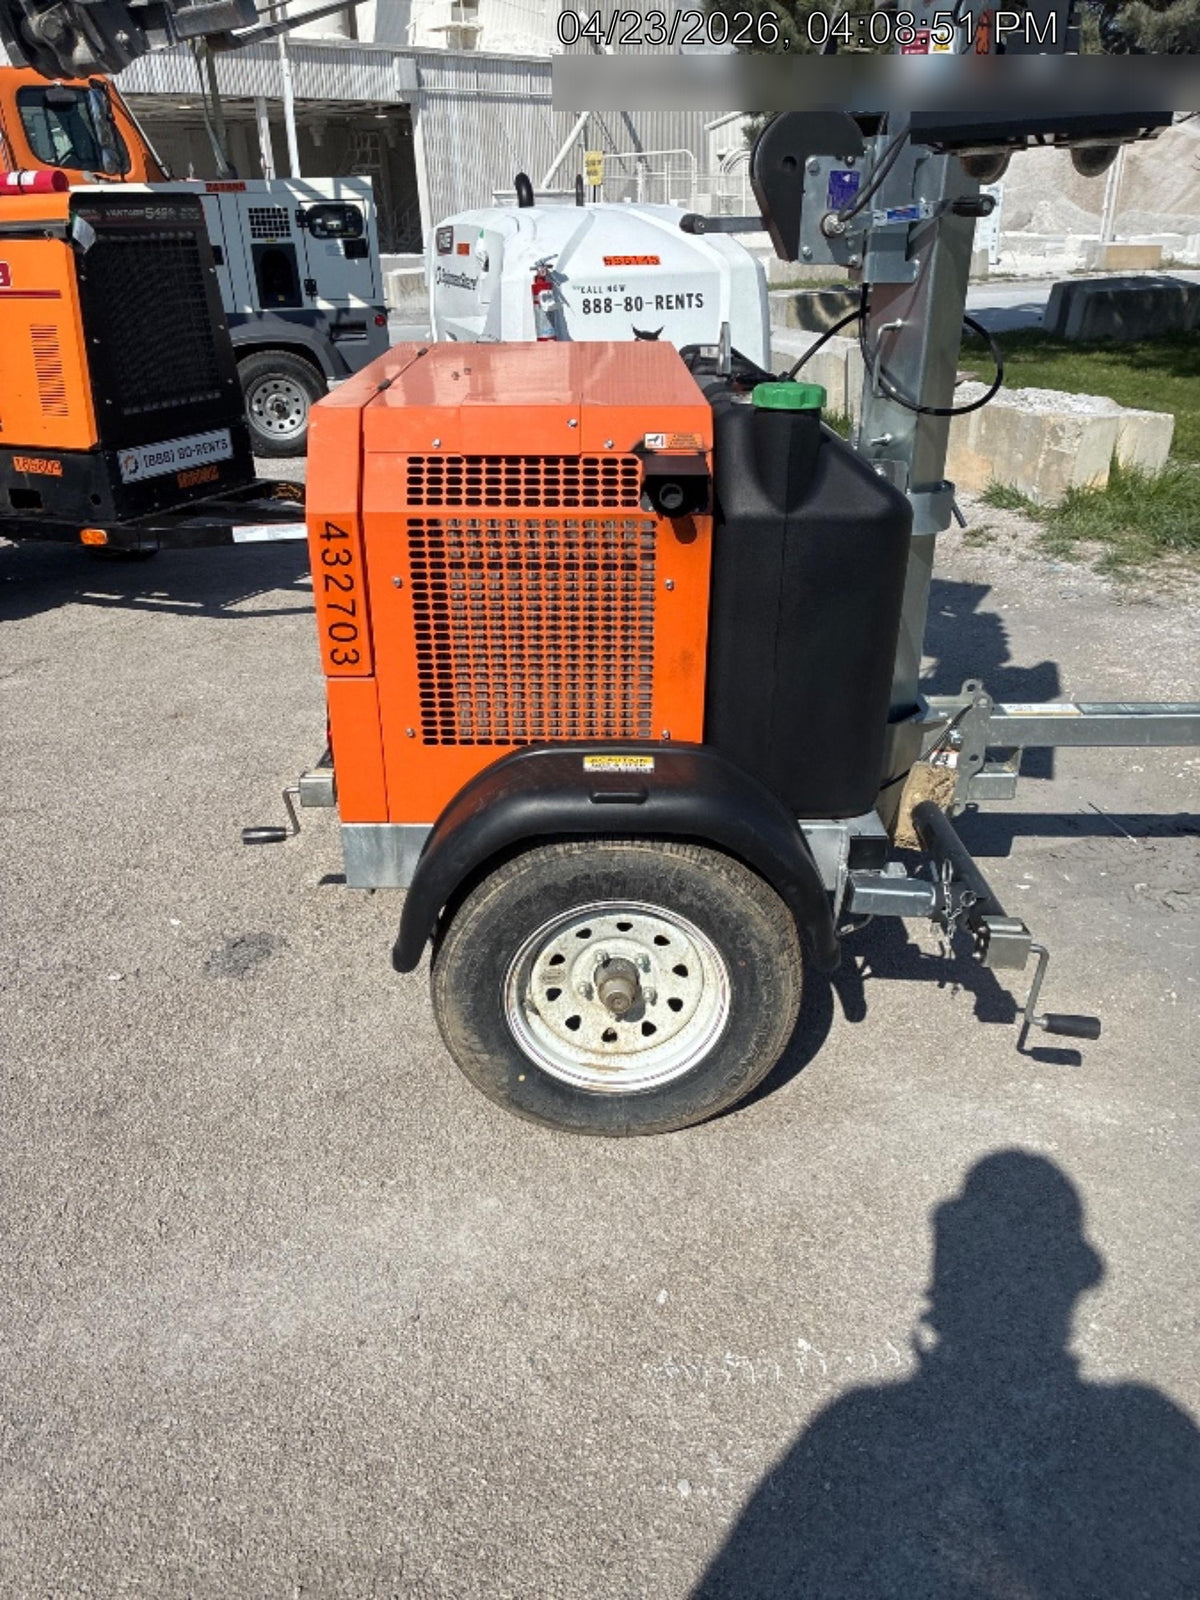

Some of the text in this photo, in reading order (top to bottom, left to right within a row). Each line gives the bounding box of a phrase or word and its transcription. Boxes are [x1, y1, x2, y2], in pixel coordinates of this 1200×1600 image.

[580, 285, 603, 294] CALL
[582, 292, 704, 315] 888-80-RENTS
[319, 521, 361, 666] 432703
